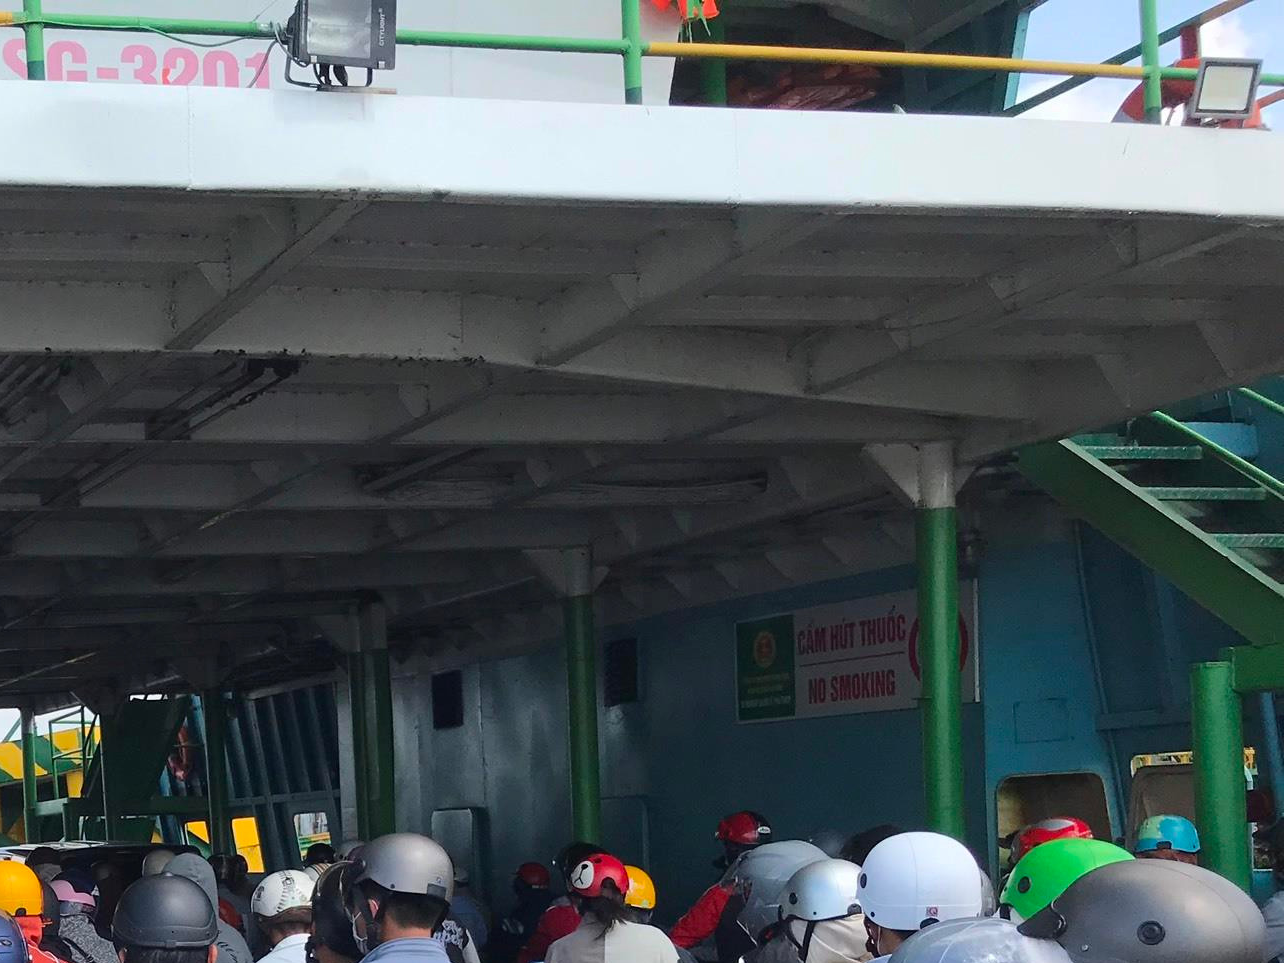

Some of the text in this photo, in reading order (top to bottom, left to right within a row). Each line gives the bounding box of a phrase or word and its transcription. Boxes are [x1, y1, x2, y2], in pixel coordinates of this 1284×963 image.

[830, 617, 856, 651] HÚT
[859, 604, 907, 645] THUỐC
[808, 677, 827, 705] NO
[830, 669, 896, 702] SMOKING
